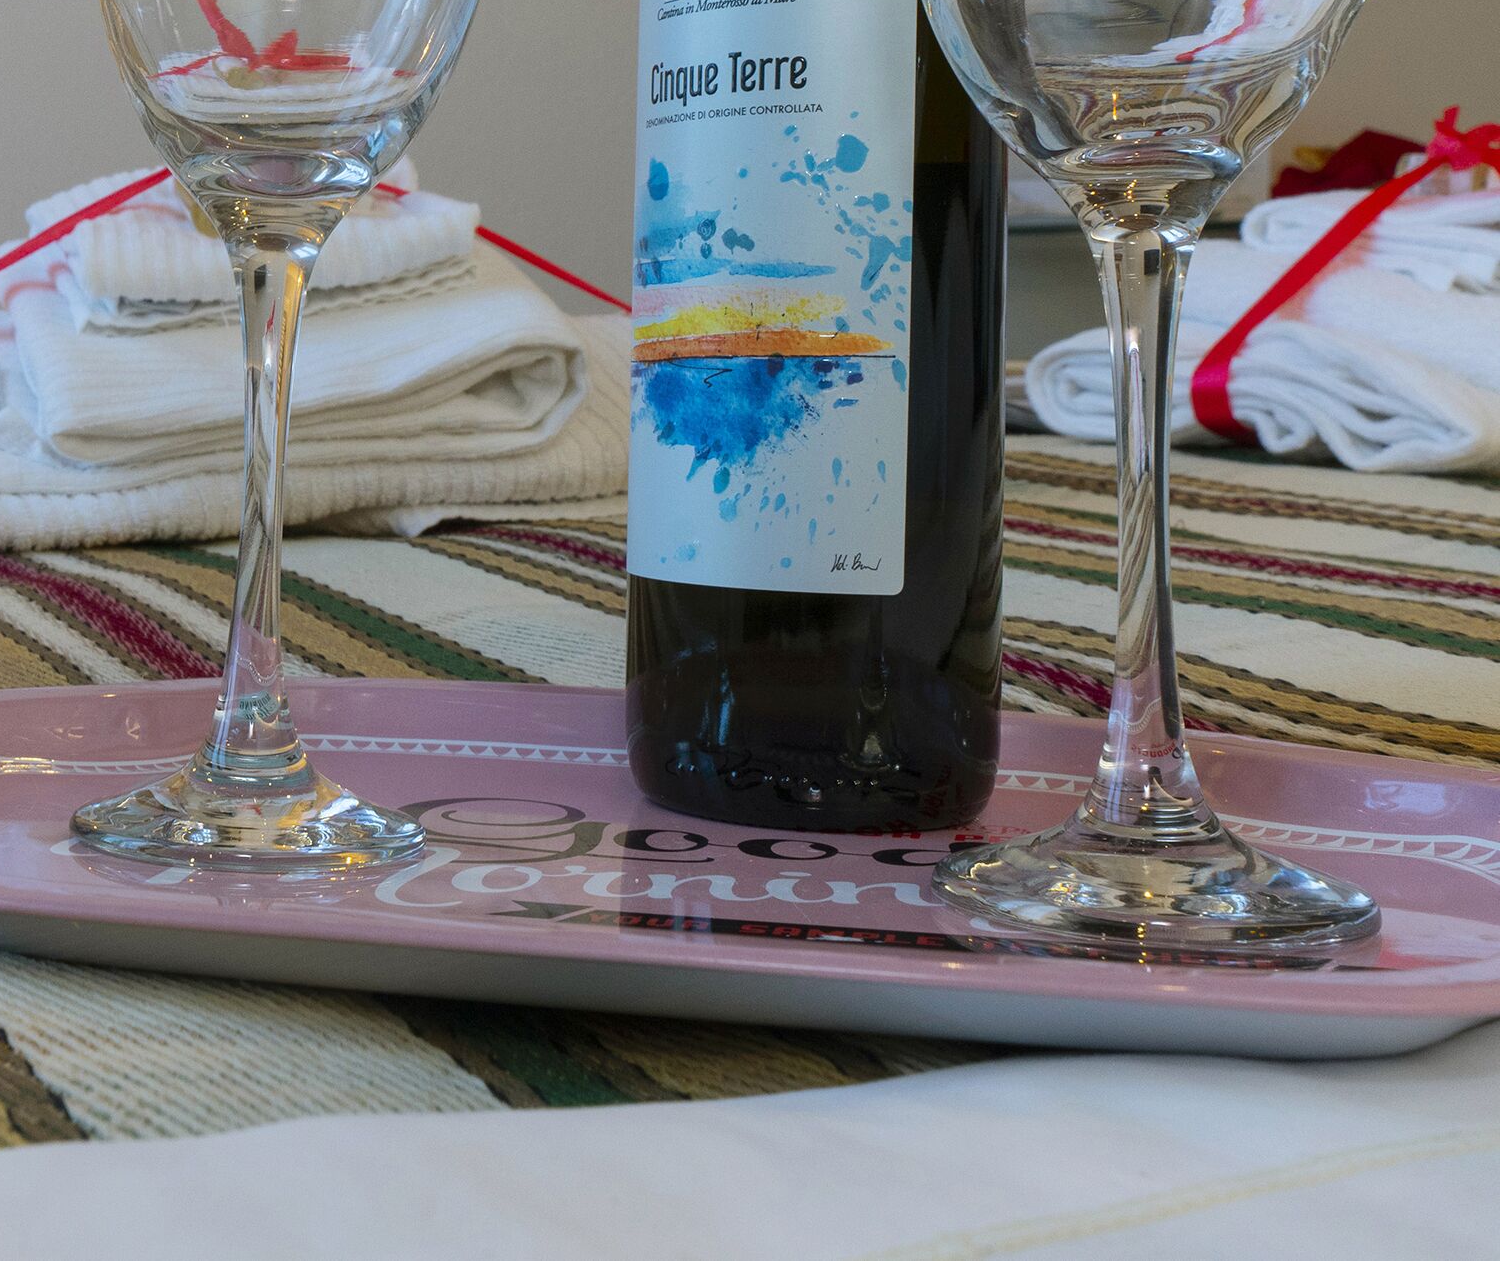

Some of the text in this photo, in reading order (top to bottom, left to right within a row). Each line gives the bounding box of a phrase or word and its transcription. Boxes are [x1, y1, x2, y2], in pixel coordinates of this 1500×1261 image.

[657, 5, 684, 21] Cantina
[685, 2, 695, 14] in
[651, 51, 808, 107] Cinque Terre
[645, 103, 824, 128] DENOMINAZIONE DI ORIGINE CONTROLLATA
